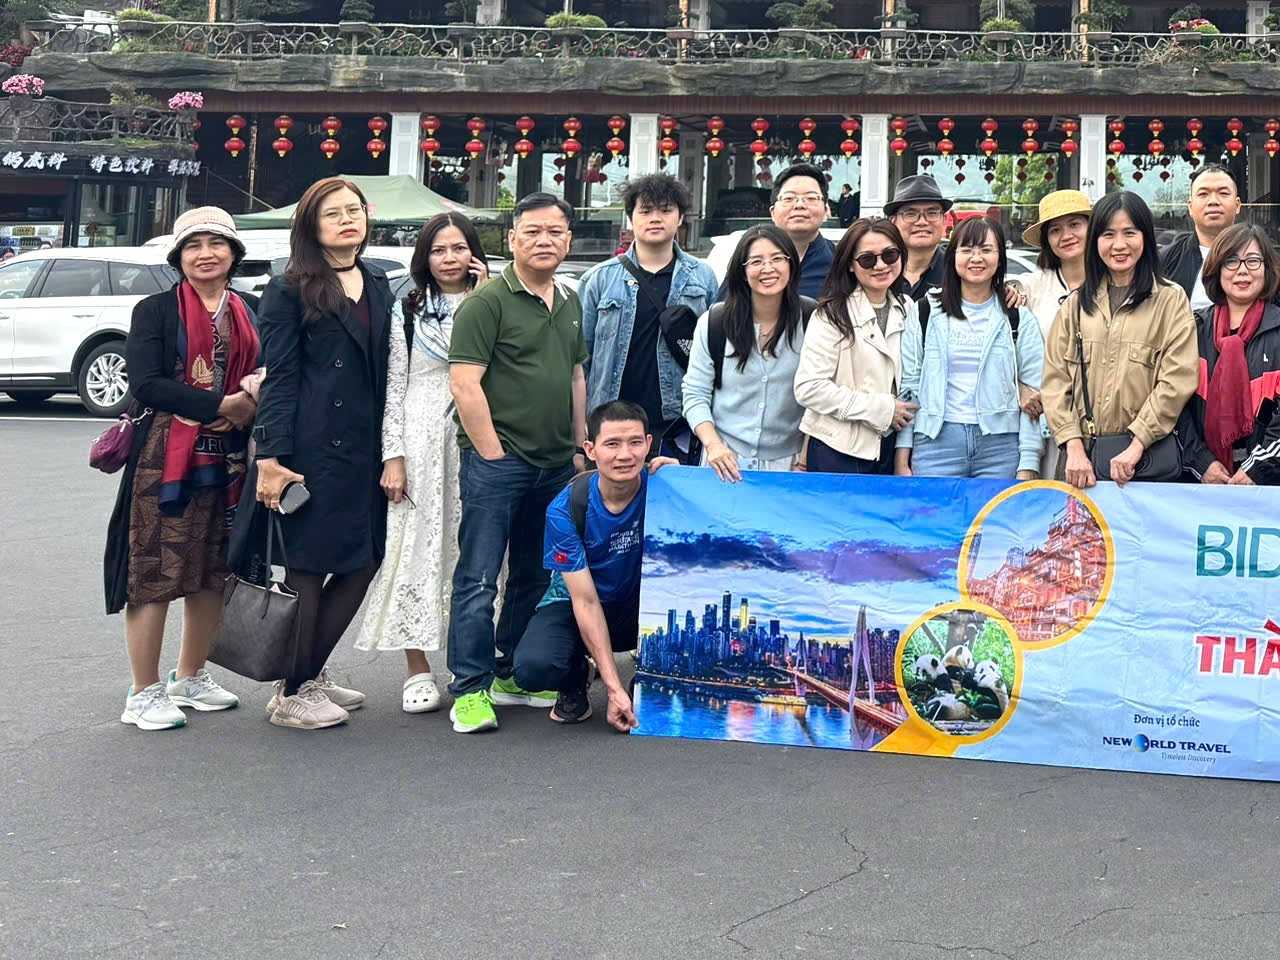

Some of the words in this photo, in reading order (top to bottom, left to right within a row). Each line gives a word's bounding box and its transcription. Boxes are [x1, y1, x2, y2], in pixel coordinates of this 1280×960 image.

[1133, 713, 1154, 725] Đơn
[1156, 714, 1165, 728] vị
[1166, 713, 1177, 726] tổ
[1178, 716, 1201, 728] chức
[1179, 740, 1232, 754] TRAVEL
